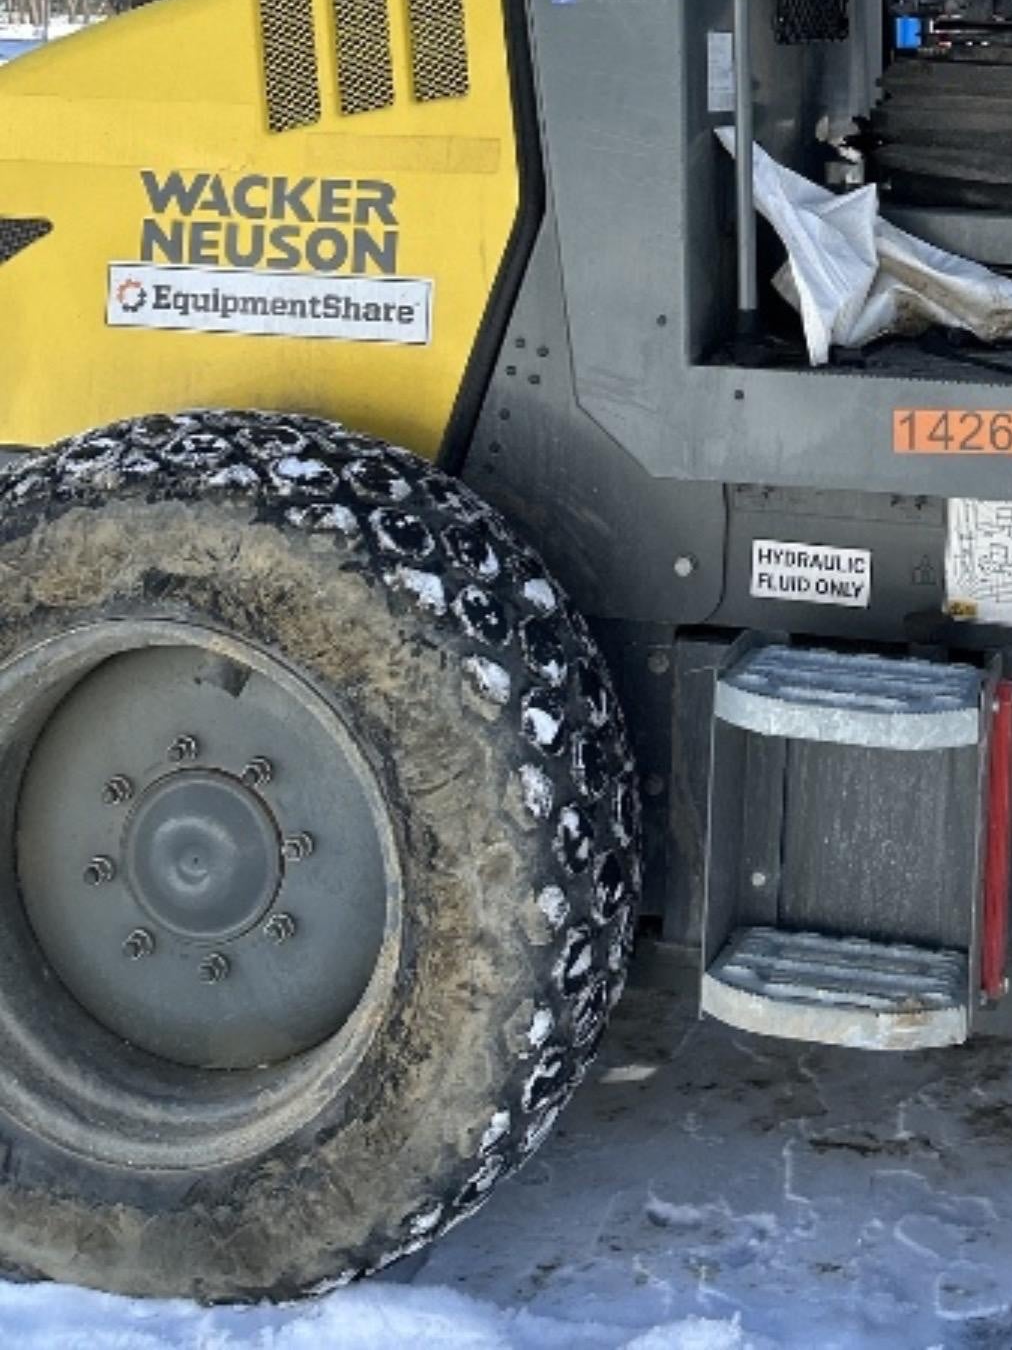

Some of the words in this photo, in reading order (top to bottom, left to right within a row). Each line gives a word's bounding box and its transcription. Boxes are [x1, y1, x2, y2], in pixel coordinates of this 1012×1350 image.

[140, 170, 398, 225] WACKER
[140, 218, 398, 274] NEUSON
[152, 284, 415, 325] EquipmentShare
[757, 547, 866, 574] HYDRAULIC
[757, 572, 811, 593] FLUID
[815, 578, 865, 599] ONLY
